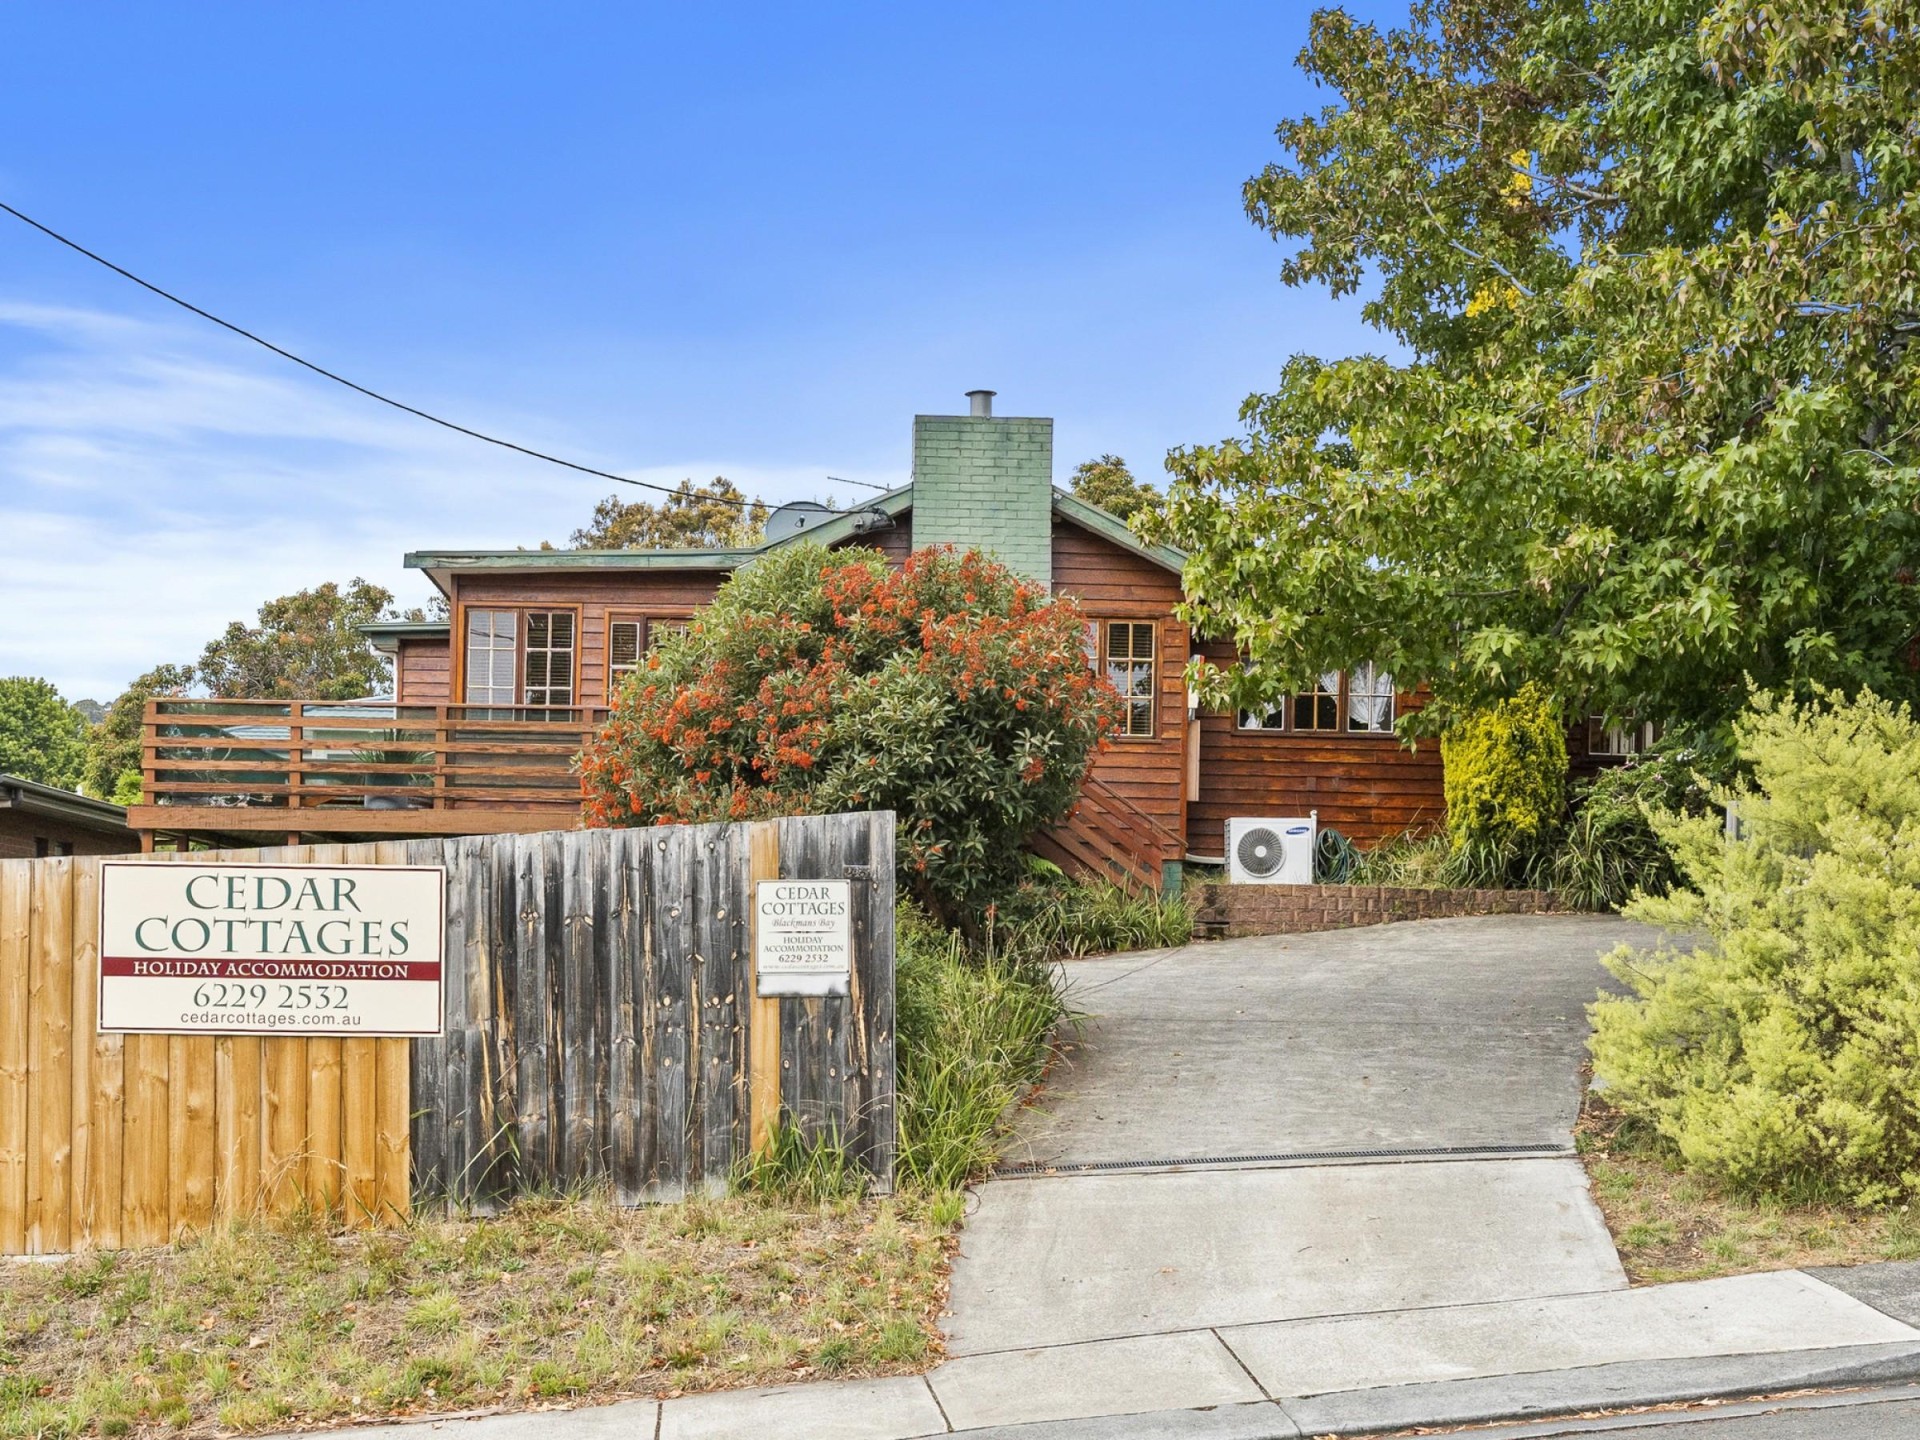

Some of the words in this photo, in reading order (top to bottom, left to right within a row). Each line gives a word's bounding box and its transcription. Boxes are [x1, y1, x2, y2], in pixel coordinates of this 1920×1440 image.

[186, 873, 362, 913] CEDAR
[775, 886, 831, 900] CEDAR
[761, 902, 845, 915] COTTAGES
[772, 917, 817, 928] Blackmans
[819, 918, 835, 929] Bay
[135, 915, 409, 959] COTTAGES
[783, 936, 823, 944] HOLIDAY
[778, 954, 803, 963] 6229
[804, 954, 829, 962] 2532
[133, 961, 222, 977] HOLIDAY
[225, 962, 409, 979] ACCOMMODATION
[193, 983, 267, 1009] 6229
[277, 984, 349, 1010] 2532
[180, 1011, 362, 1028] cedarcottages.com.au
